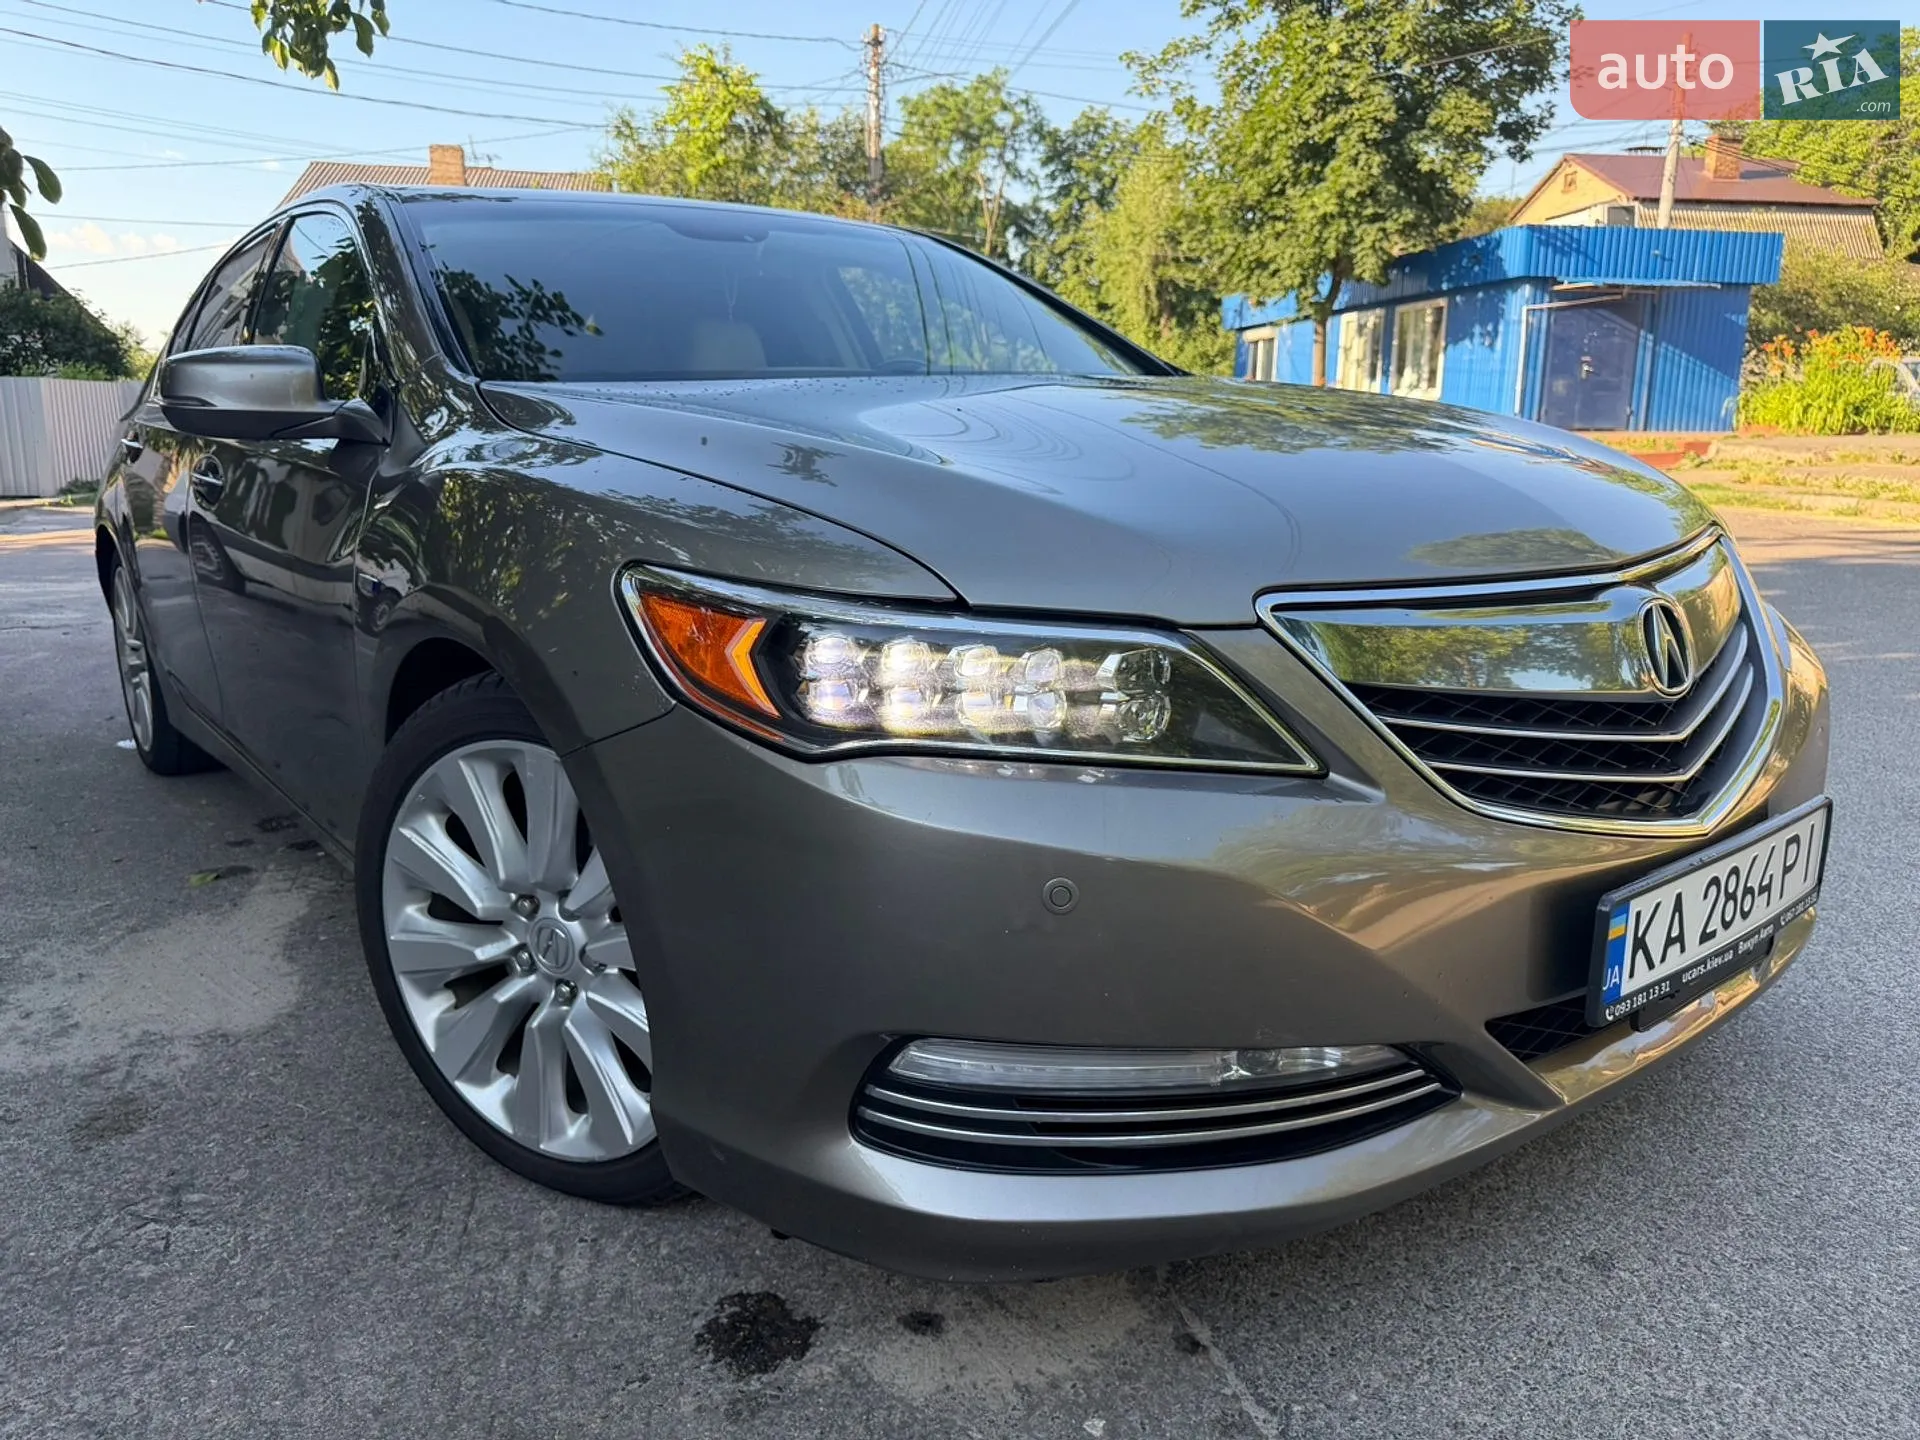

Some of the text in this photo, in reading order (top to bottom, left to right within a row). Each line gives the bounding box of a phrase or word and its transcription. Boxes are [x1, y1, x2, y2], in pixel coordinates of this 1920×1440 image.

[1628, 892, 1687, 979] KA
[1698, 844, 1776, 946] 2864
[1779, 823, 1815, 900] PI
[1682, 949, 1734, 983] ucars.kiev.ua
[1614, 980, 1671, 1016] 093 181 13 31
